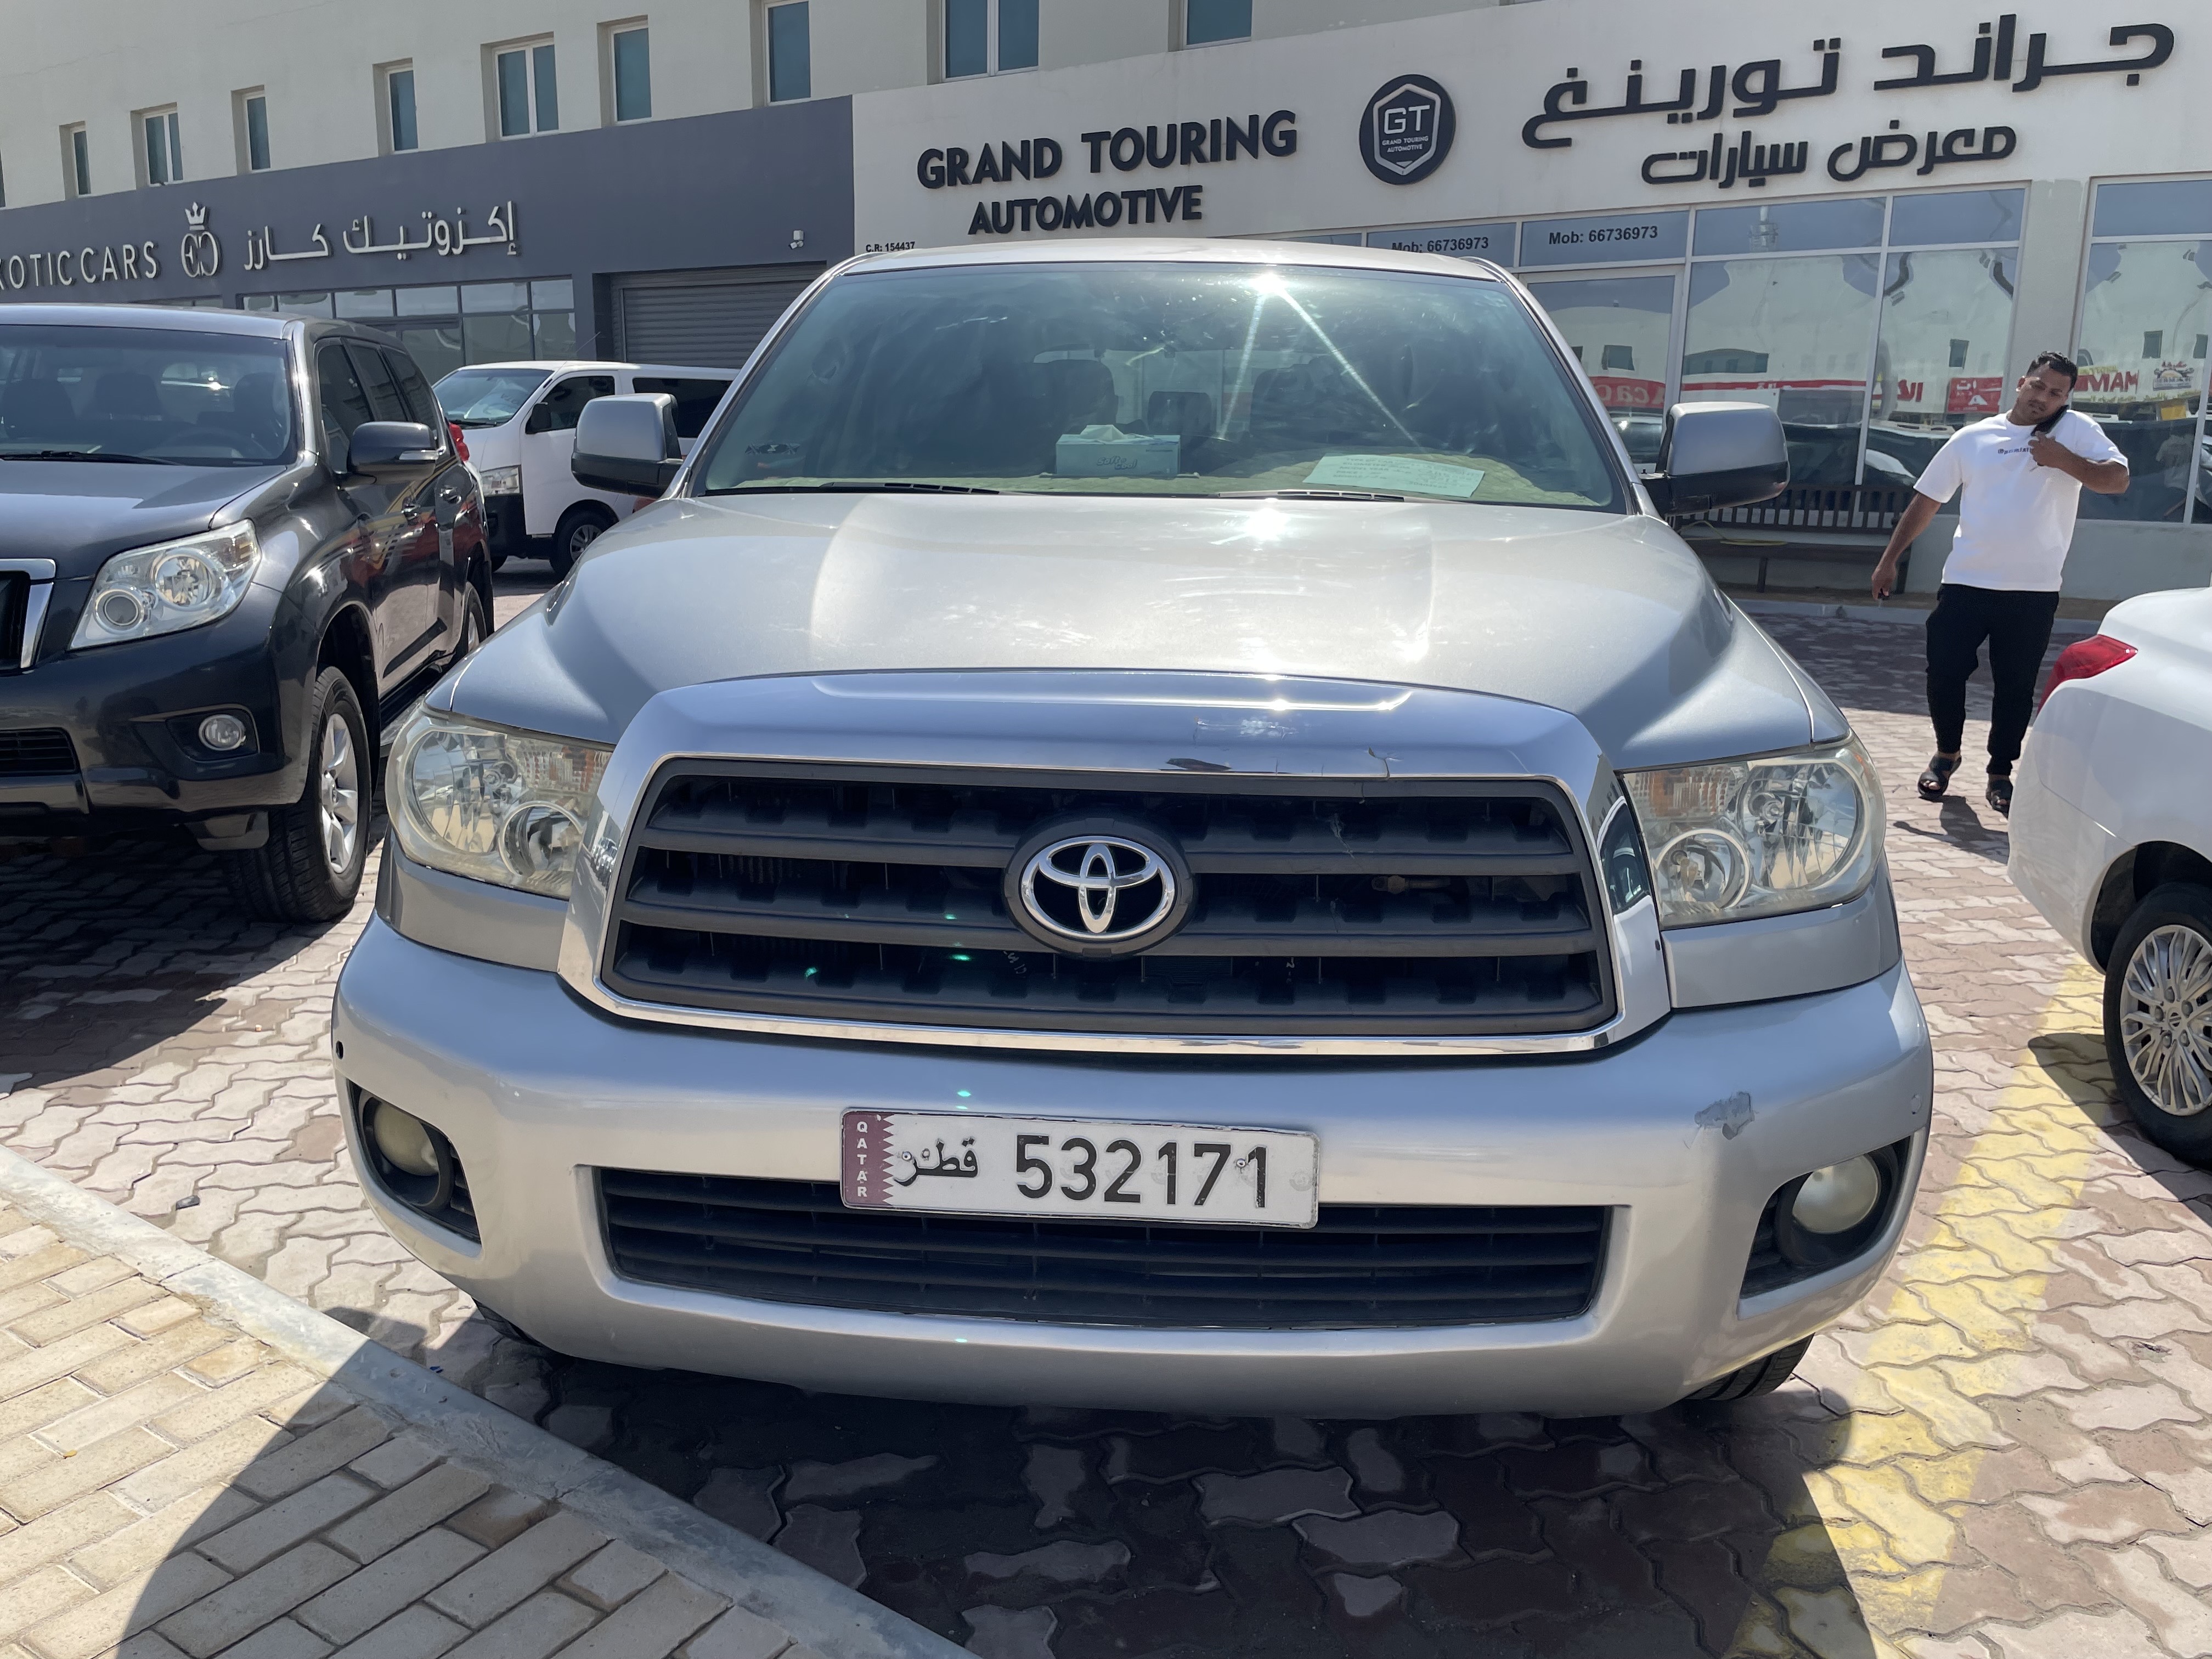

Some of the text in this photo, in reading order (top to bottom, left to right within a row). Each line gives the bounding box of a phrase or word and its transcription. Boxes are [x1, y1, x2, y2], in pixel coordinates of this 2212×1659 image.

[1522, 14, 2175, 149] جراند تورينغ
[1384, 104, 1430, 134] GT
[917, 110, 1297, 190] GRAND TOURING
[1387, 144, 1423, 153] AUTOMOTIVE
[1641, 120, 2017, 189] معرض سيارات
[968, 184, 1203, 235] AUTOMOTIVE
[244, 201, 517, 270] إكزوتيك كارز
[885, 241, 916, 251] 154437
[1391, 236, 1489, 253] Mob: 66736973
[1549, 225, 1658, 245] Mob: 66736973
[80, 241, 156, 283] CARS
[856, 1121, 868, 1198] QATAR
[893, 1137, 978, 1187] قطر
[1016, 1135, 1267, 1208] 532171
